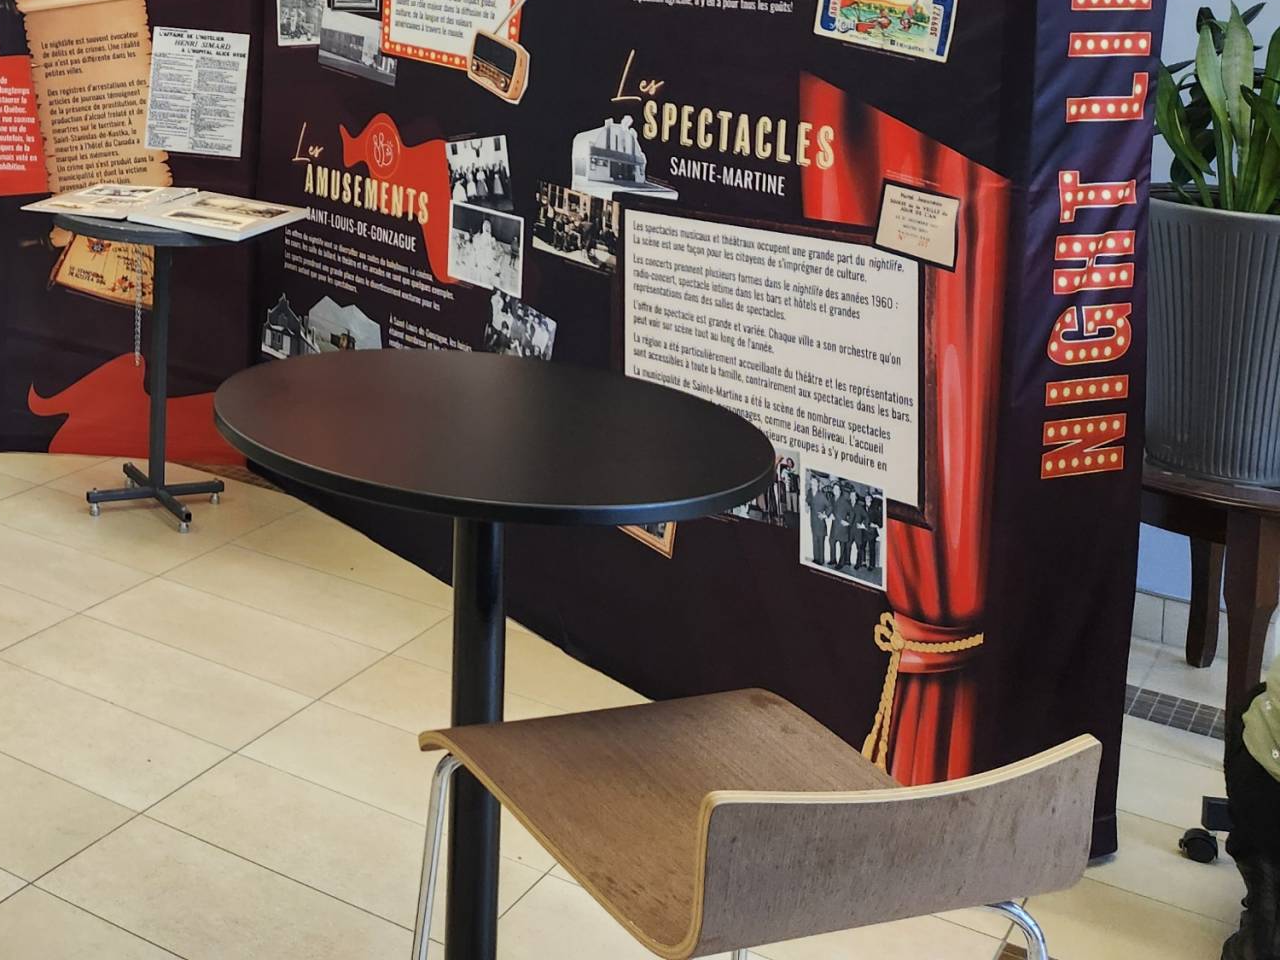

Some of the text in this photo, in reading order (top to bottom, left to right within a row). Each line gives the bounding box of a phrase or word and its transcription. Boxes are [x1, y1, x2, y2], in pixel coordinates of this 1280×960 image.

[611, 49, 665, 102] Les
[292, 122, 324, 162] Les
[643, 100, 834, 170] SPECTACLES
[304, 163, 429, 225] AMUSEMENTS
[669, 156, 785, 196] SAINTE-MARTINE
[632, 220, 643, 231] Les
[792, 246, 805, 256] une
[808, 247, 834, 263] grande
[836, 250, 852, 266] part
[855, 252, 865, 265] du
[868, 256, 904, 274] nightlife.
[633, 254, 643, 266] Les
[764, 275, 781, 289] dans
[783, 279, 789, 290] le
[825, 286, 838, 299] des
[840, 288, 868, 304] années
[872, 293, 892, 308] 1960
